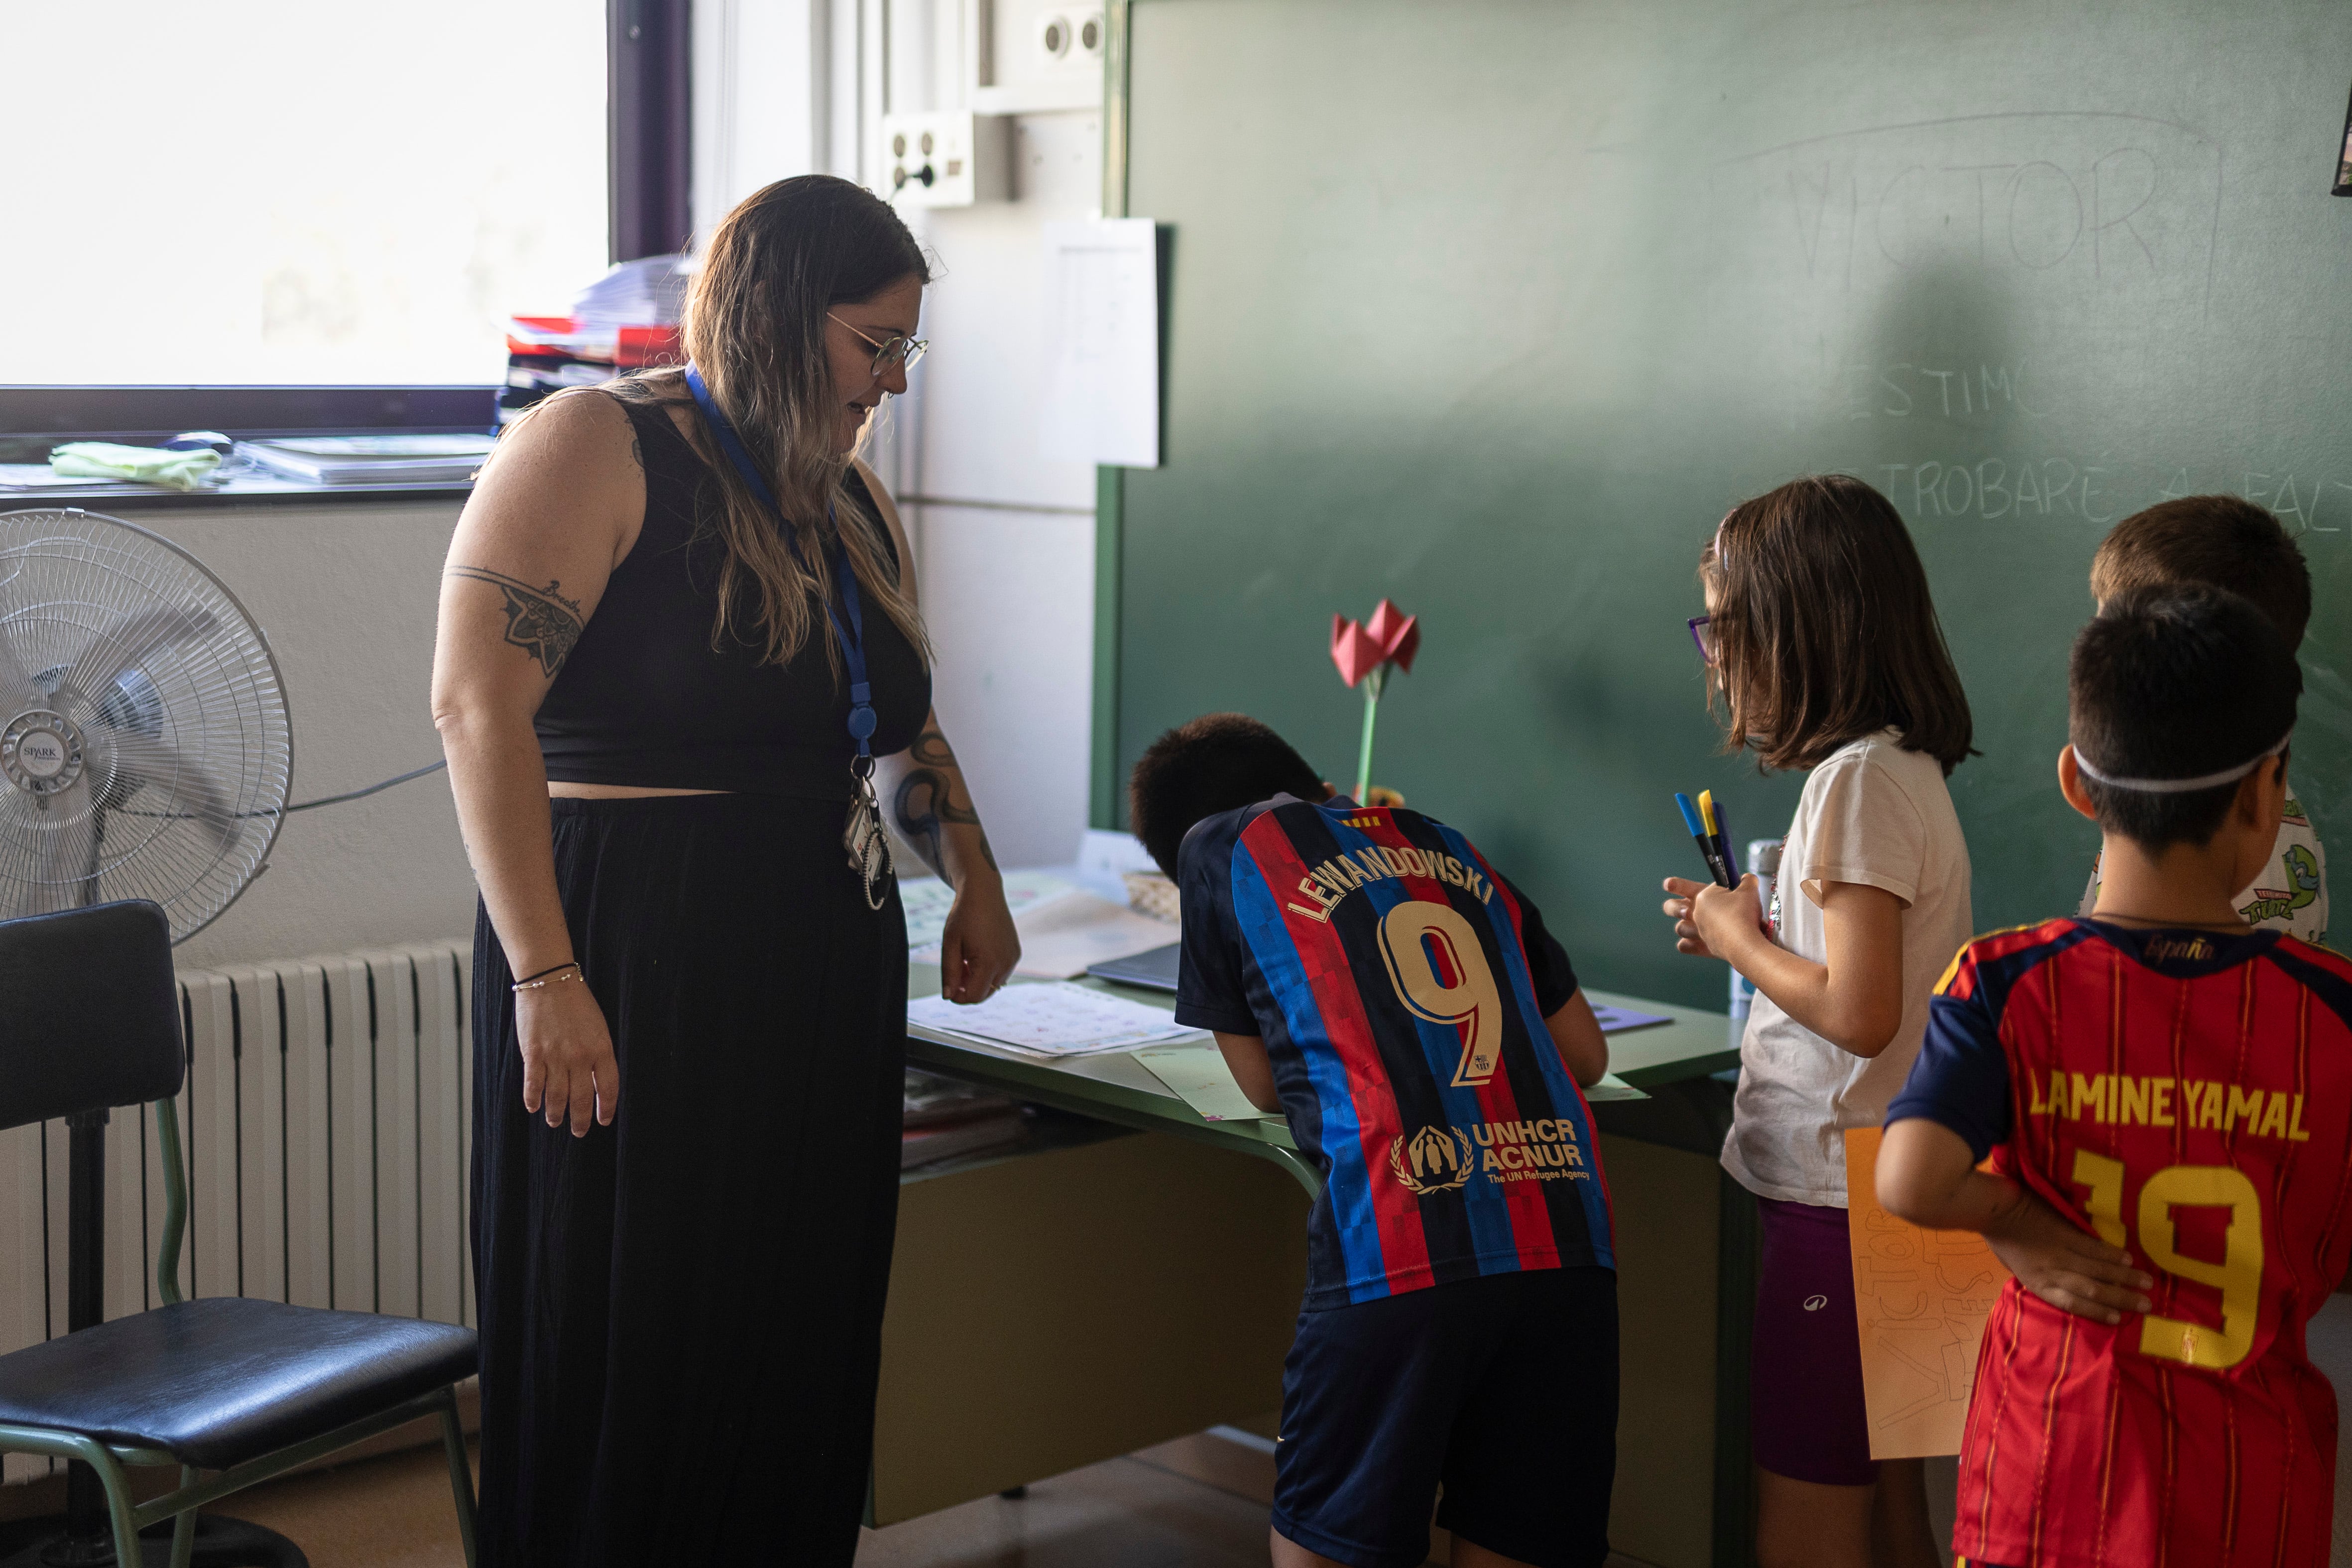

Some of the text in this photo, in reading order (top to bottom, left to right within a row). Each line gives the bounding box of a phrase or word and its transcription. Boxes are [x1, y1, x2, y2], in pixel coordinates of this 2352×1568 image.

[24, 747, 56, 760] SPARK
[1288, 846, 1494, 924] LEWANDOWSKI
[1377, 900, 1502, 1086] 9
[1472, 1119, 1577, 1146] UNHCR
[1483, 1144, 1584, 1172] ACNUR
[1487, 1169, 1590, 1184] The UN Refugee Agency
[2071, 1149, 2264, 1371] 19
